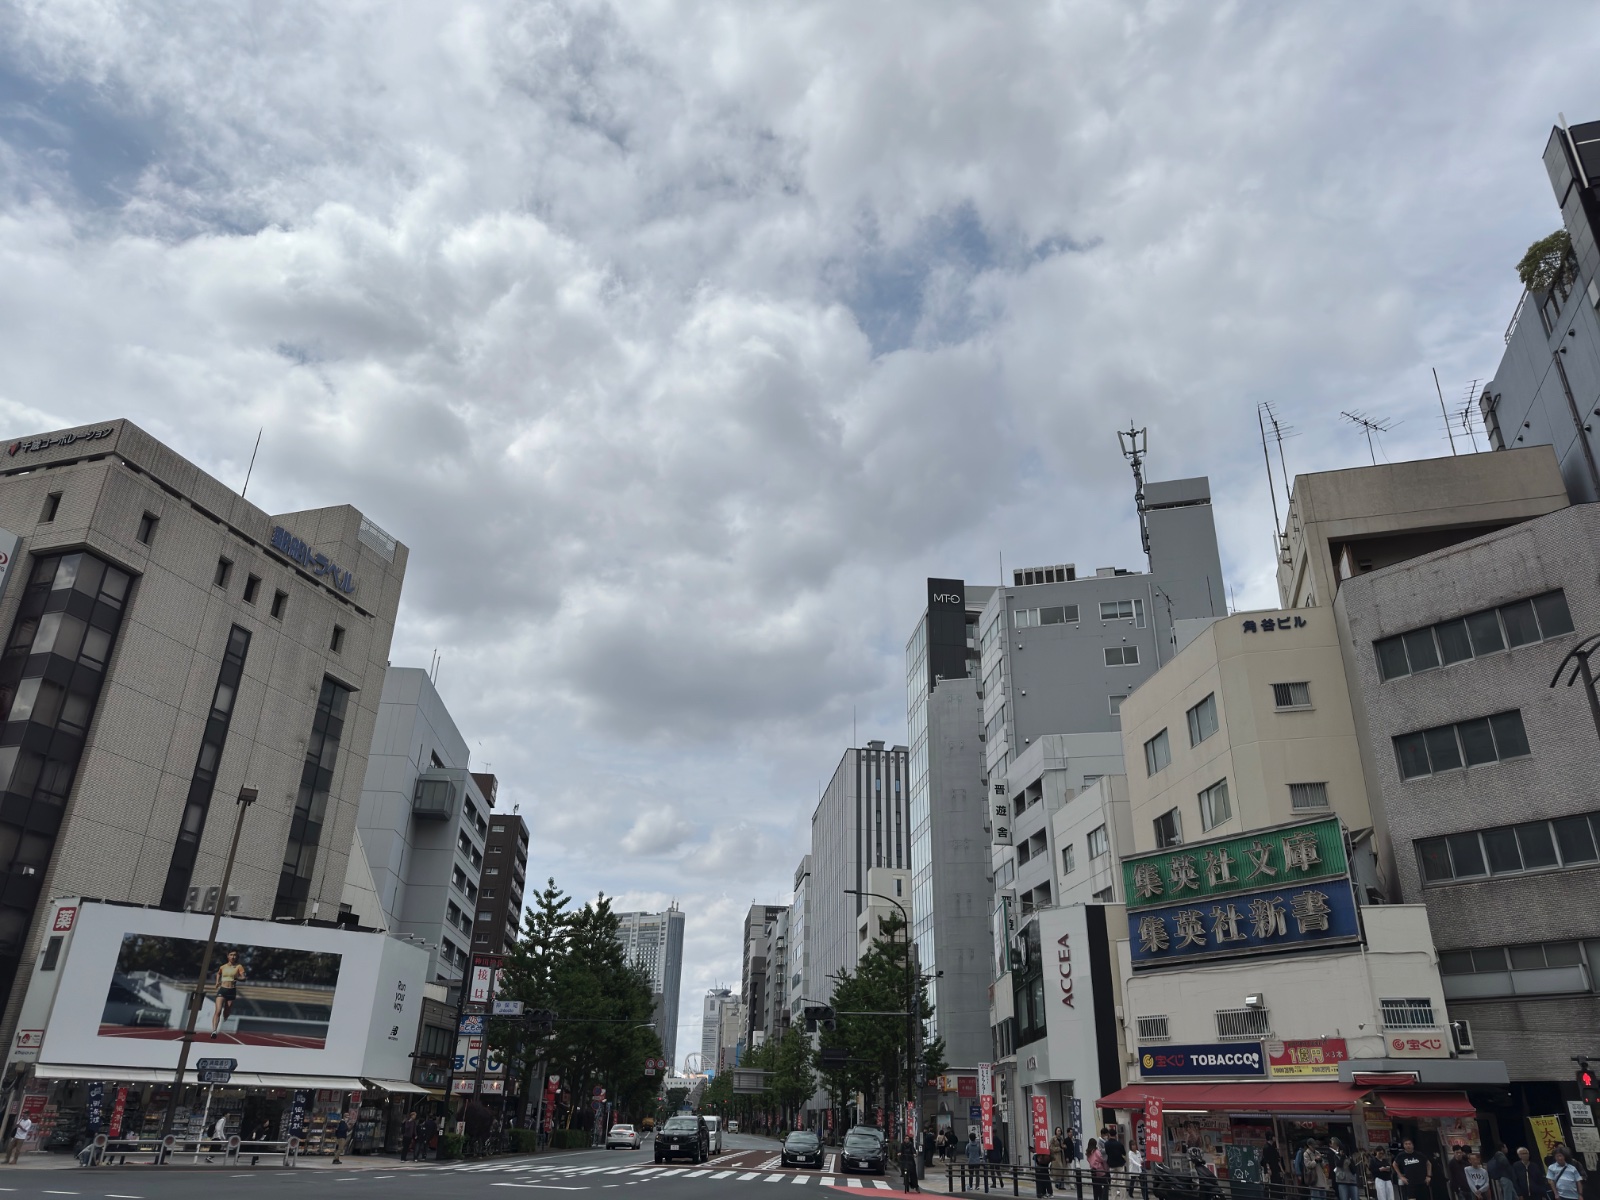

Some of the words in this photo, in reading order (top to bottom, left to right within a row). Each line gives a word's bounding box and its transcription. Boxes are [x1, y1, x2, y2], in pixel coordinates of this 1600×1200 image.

[22, 427, 114, 453] 千歳コーポレーション
[1242, 615, 1307, 634] 角谷ビル
[994, 784, 1008, 839] 晋遊舎
[1132, 831, 1323, 899] 集英社文庫
[55, 909, 75, 929] 薬
[1137, 890, 1332, 953] 集英社新書
[1057, 933, 1075, 1009] ACCEA
[397, 980, 407, 992] Run
[1406, 1039, 1441, 1050] 宝くじ
[1155, 1054, 1185, 1068] 宝くじ
[1190, 1052, 1253, 1066] TOBACCO
[1287, 1046, 1324, 1064] 1億円
